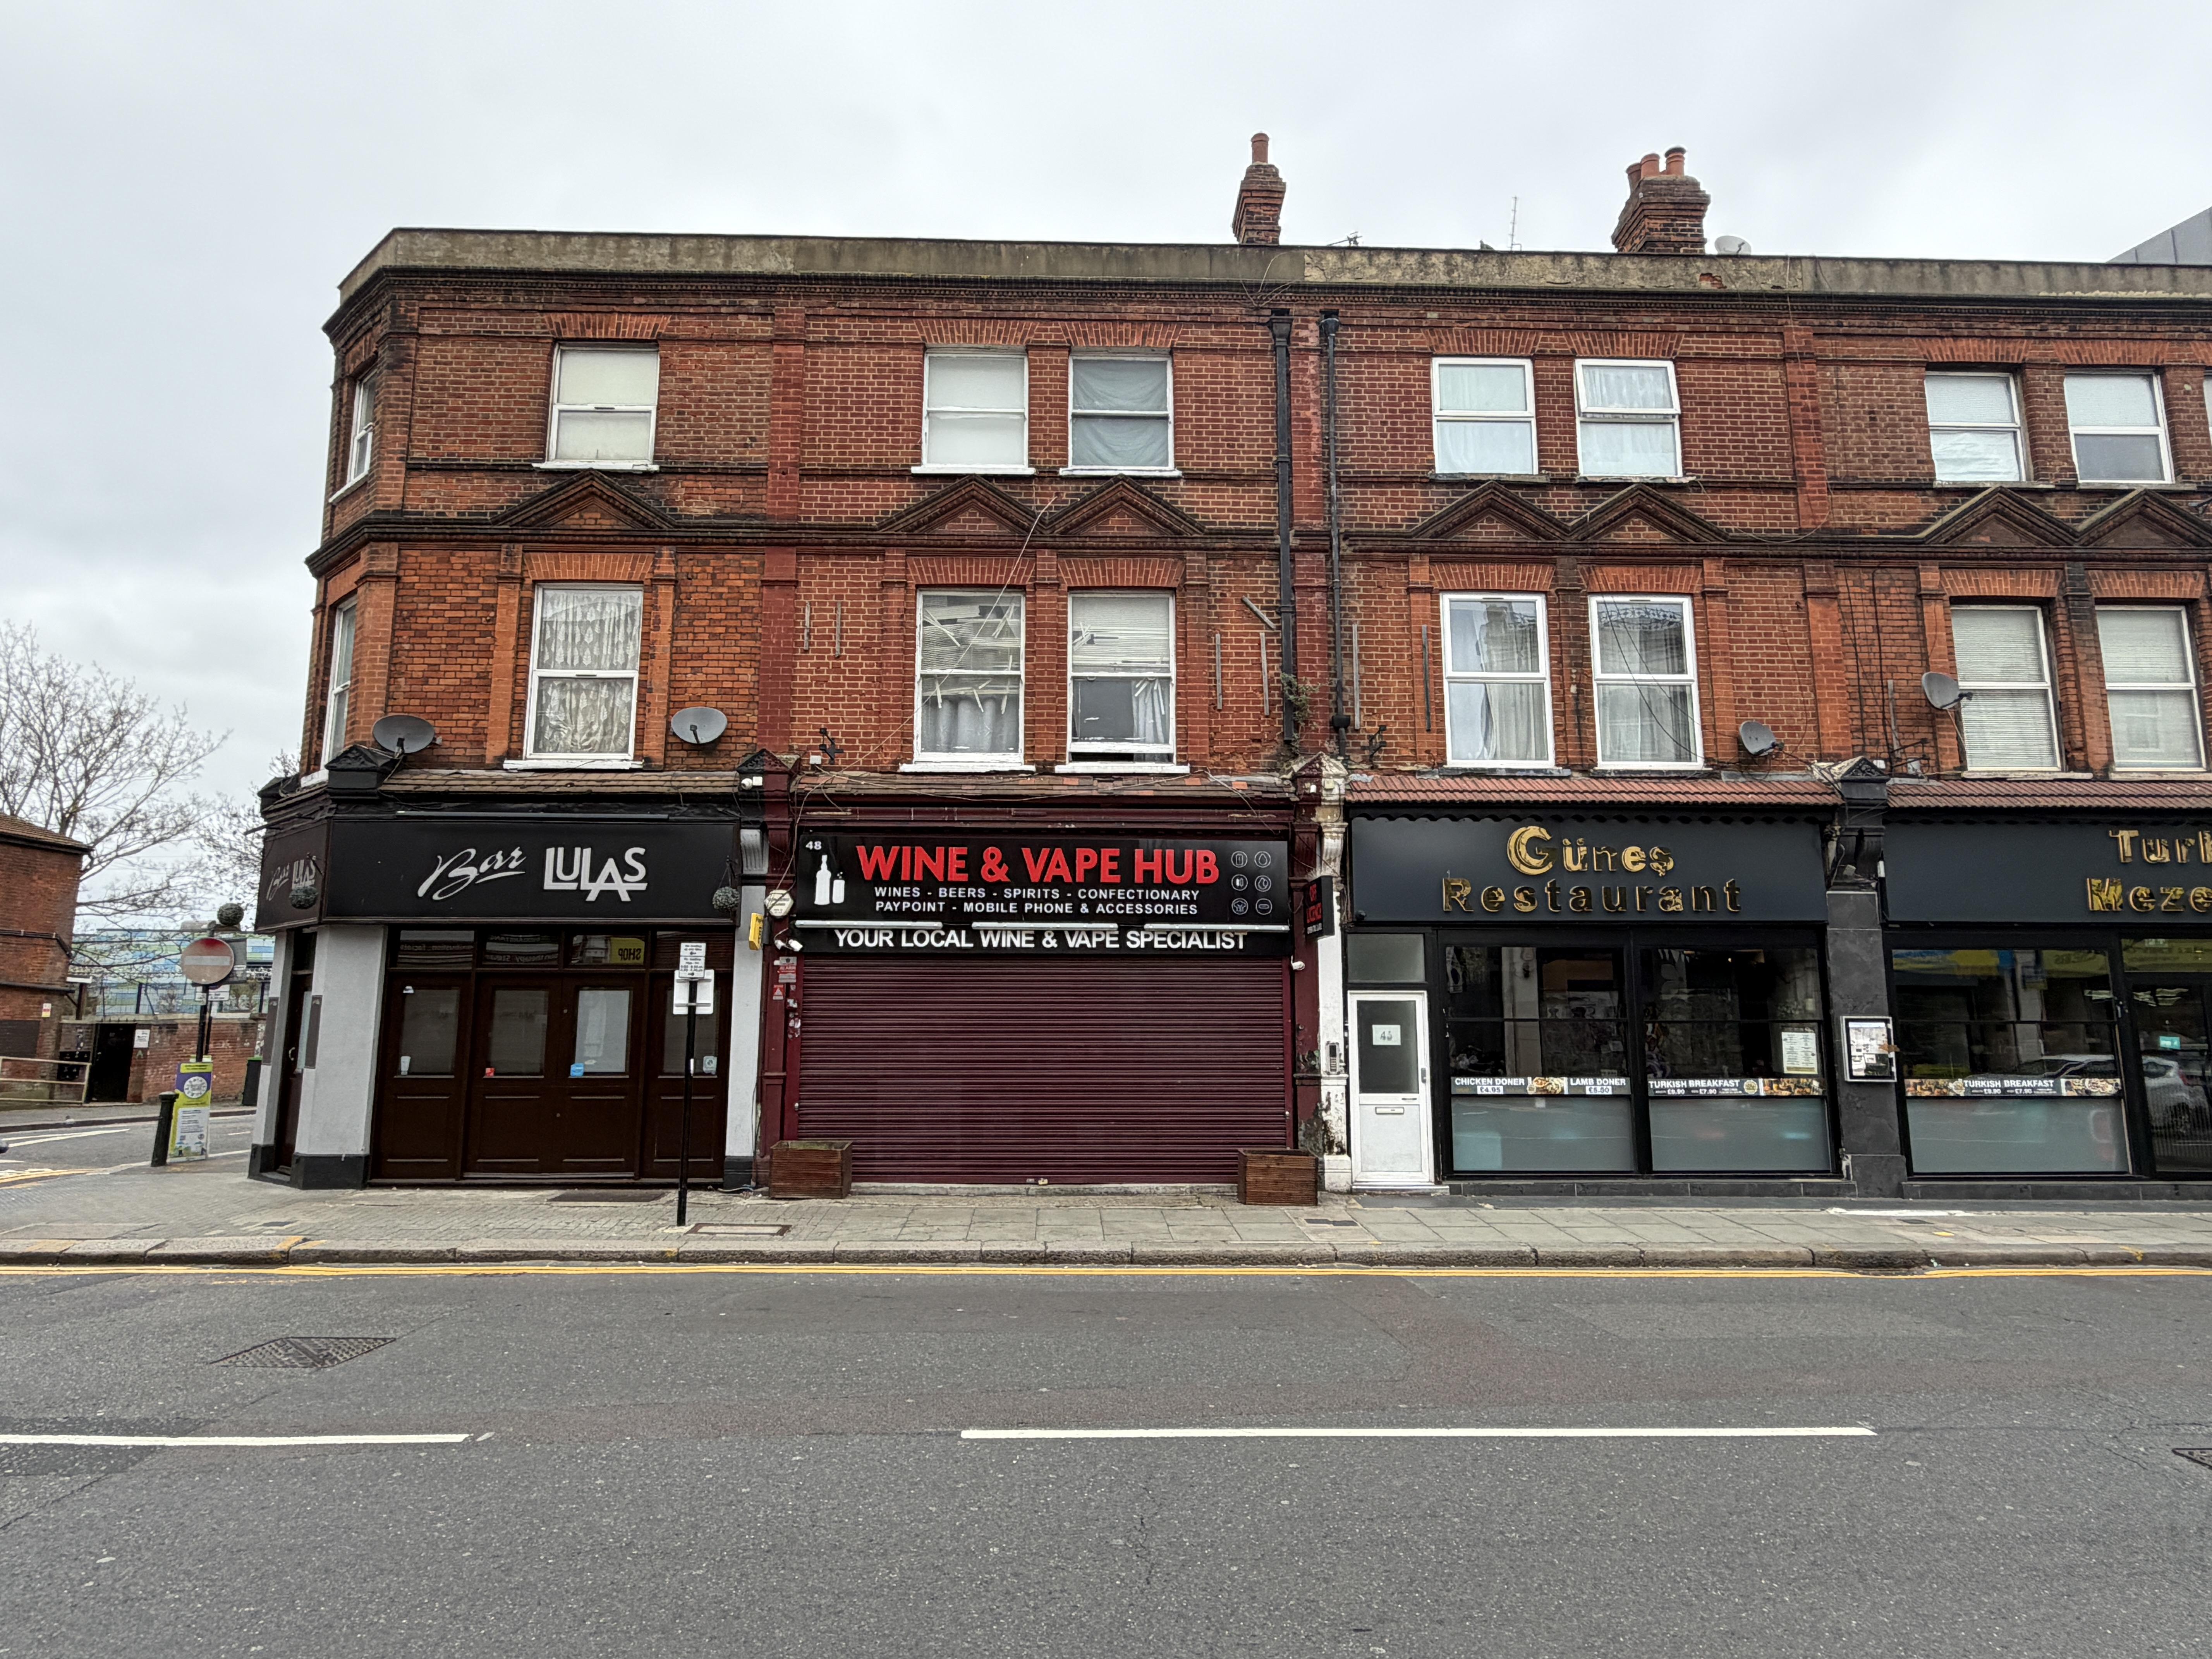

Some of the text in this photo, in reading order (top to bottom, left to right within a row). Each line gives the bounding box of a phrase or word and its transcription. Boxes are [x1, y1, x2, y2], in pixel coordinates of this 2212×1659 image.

[805, 841, 822, 850] 48
[417, 847, 647, 902] Bar LULAS
[856, 846, 1219, 884] WINE & VAPE HUB
[875, 887, 921, 898] WINES
[939, 888, 986, 898] BEERS
[1004, 888, 1060, 899] SPIRITS
[1078, 889, 1200, 900] CONFECTIONARY
[1442, 878, 1741, 913] Restaurant
[2087, 878, 2212, 912] Meze
[876, 902, 945, 912] PAYPOINT
[963, 903, 1018, 913] MOBILE
[1025, 903, 1073, 914] PHONE
[1080, 903, 1089, 914] &
[1096, 903, 1198, 915] ACCESSORIES
[835, 929, 1248, 950] YOUR LOCAL WINE & VAPE SPECIALIST
